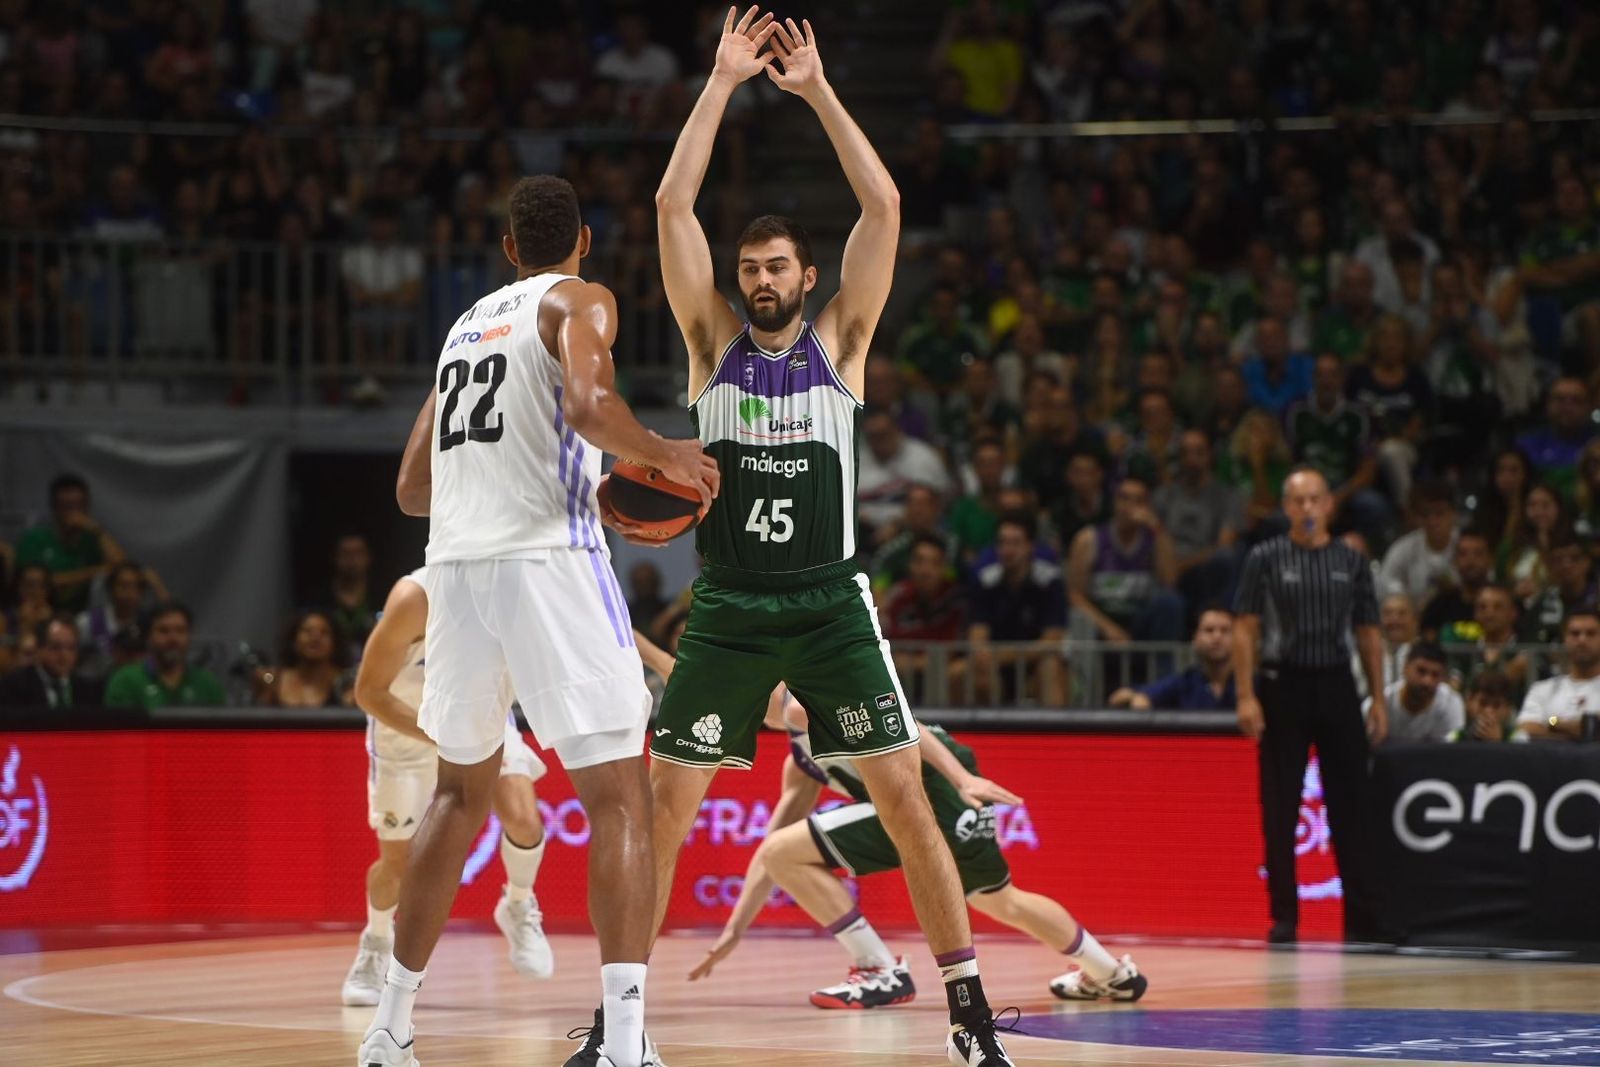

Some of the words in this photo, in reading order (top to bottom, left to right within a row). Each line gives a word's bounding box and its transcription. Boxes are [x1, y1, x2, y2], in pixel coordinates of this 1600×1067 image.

[439, 353, 507, 452] 22
[745, 498, 794, 543] 45
[840, 720, 874, 739] laga
